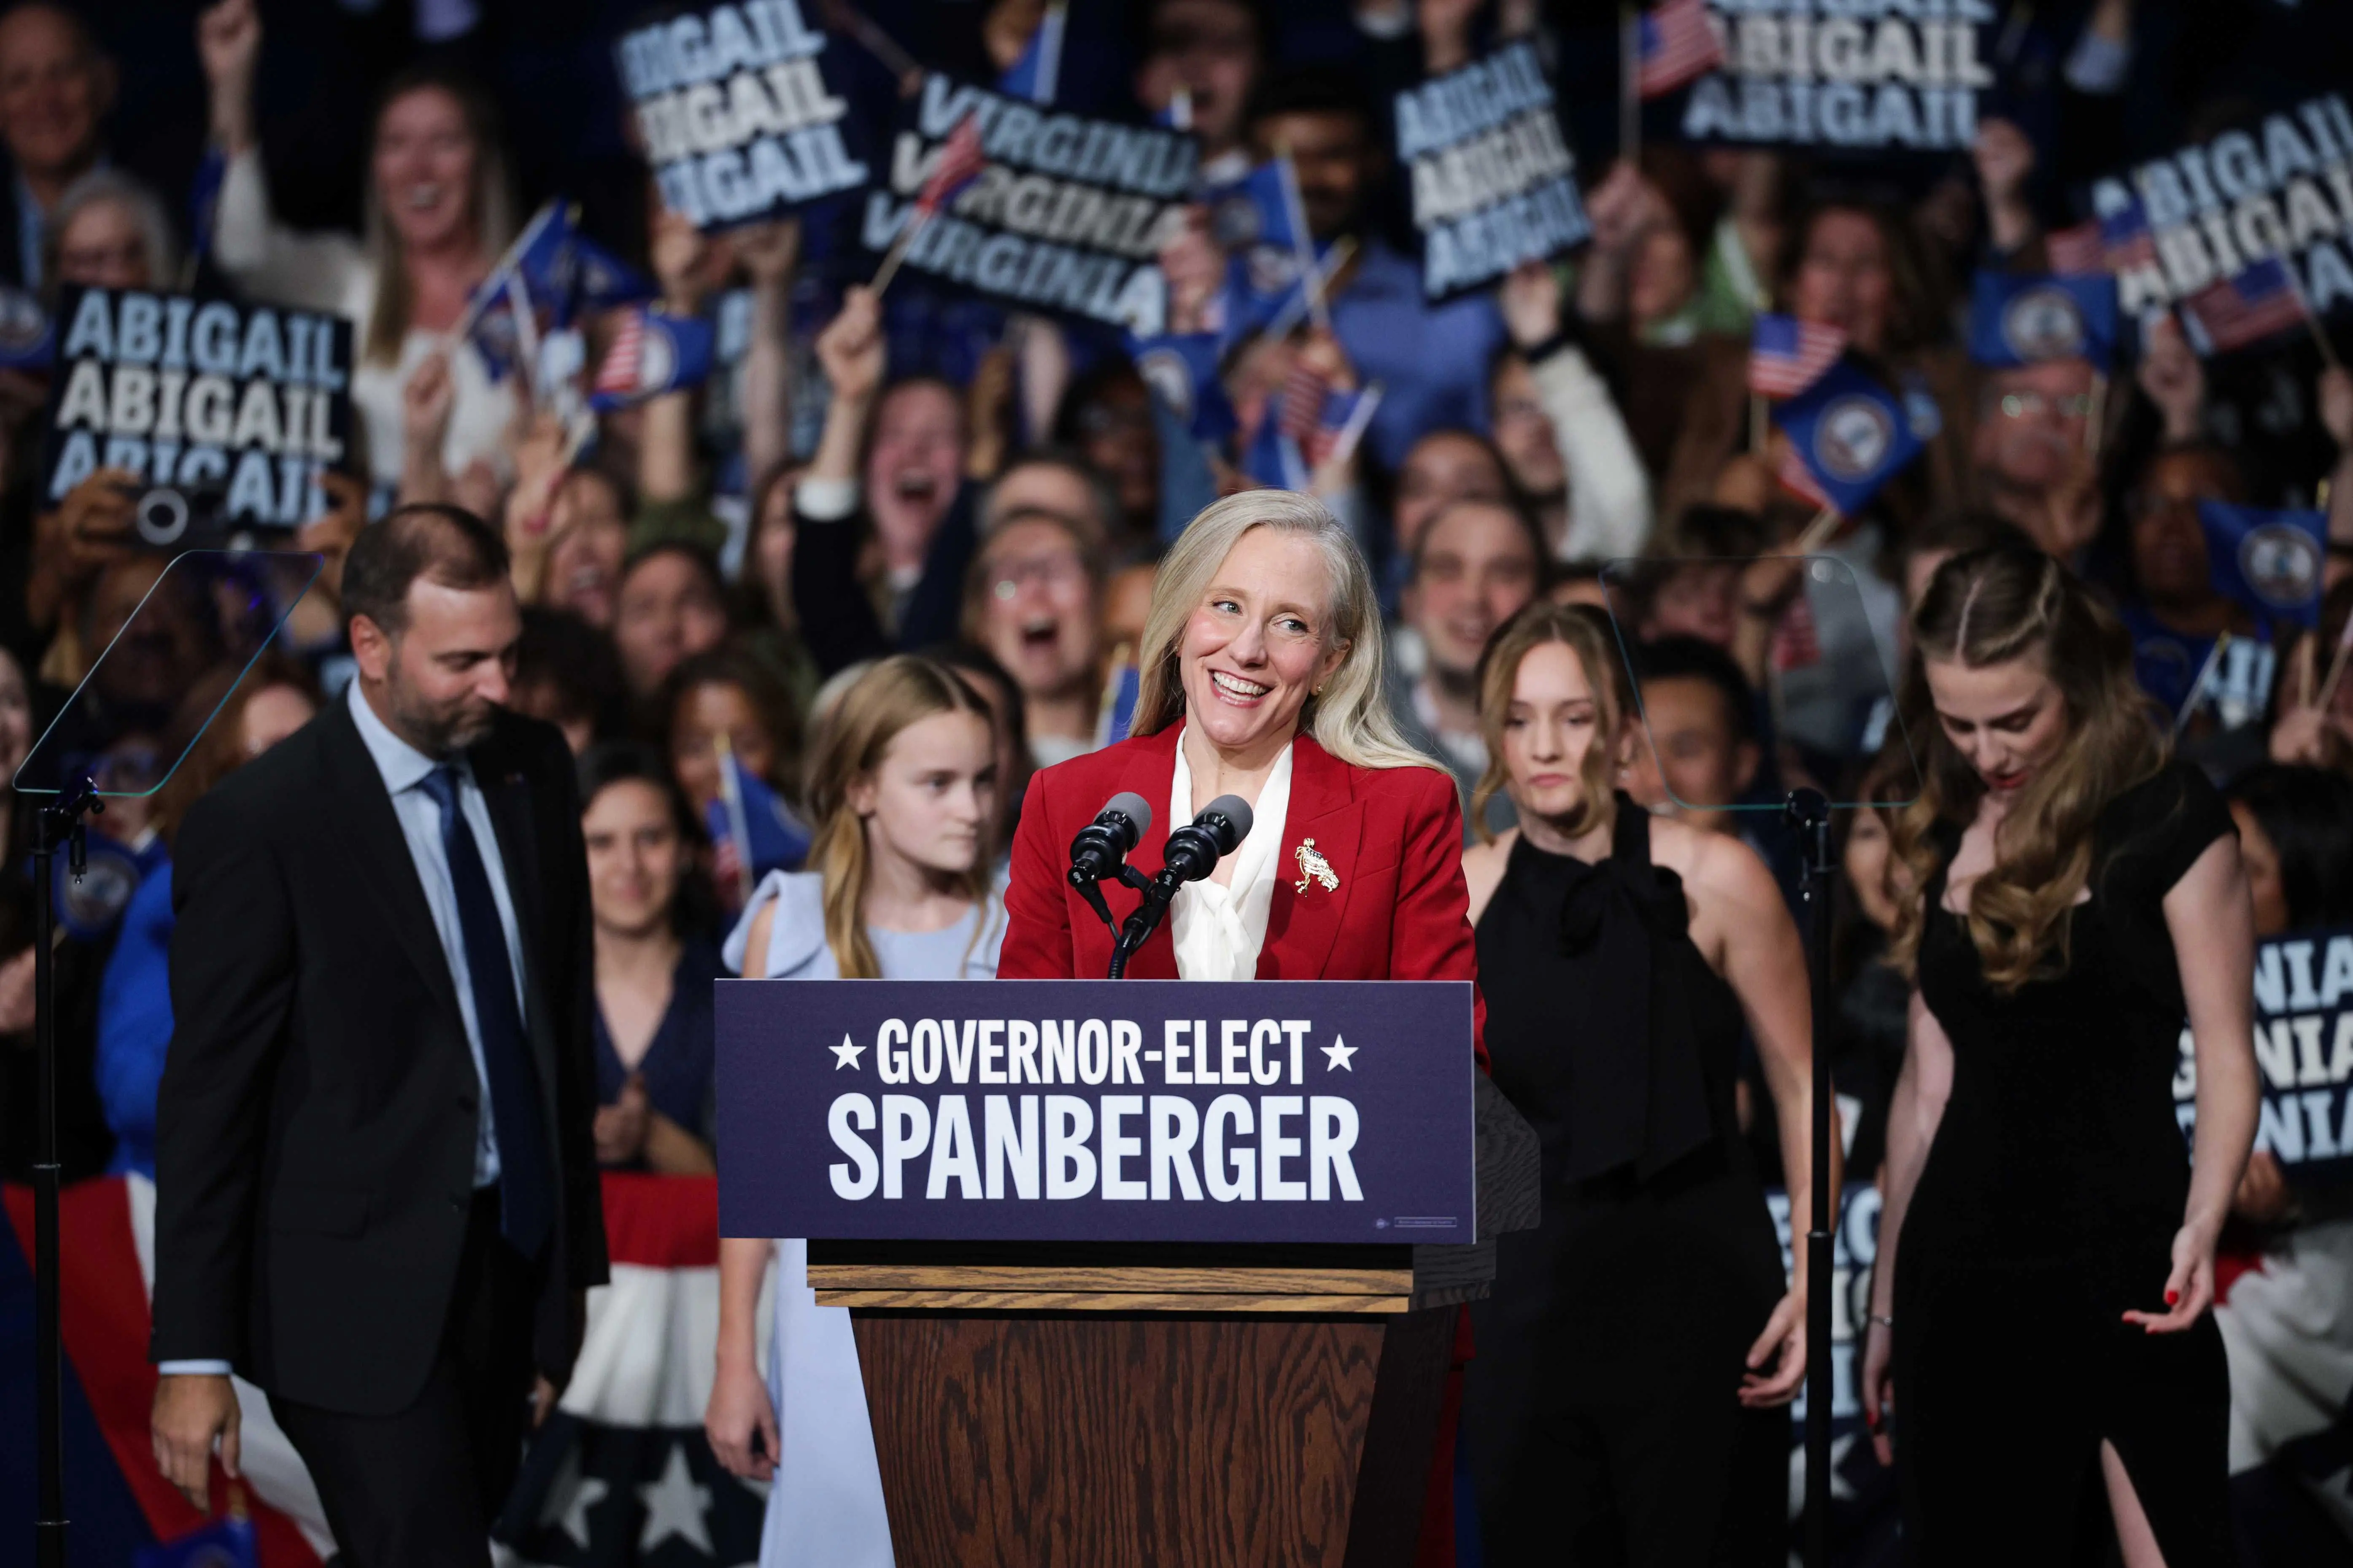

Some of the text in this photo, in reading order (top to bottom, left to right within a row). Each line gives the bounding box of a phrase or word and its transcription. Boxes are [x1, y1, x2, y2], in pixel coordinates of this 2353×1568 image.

[63, 288, 346, 390] ABIGAIL
[55, 358, 344, 461] ABIGAIL
[876, 1018, 1311, 1085] GOVERNOR-ELECT
[827, 1092, 1365, 1202] SPANBERGER
